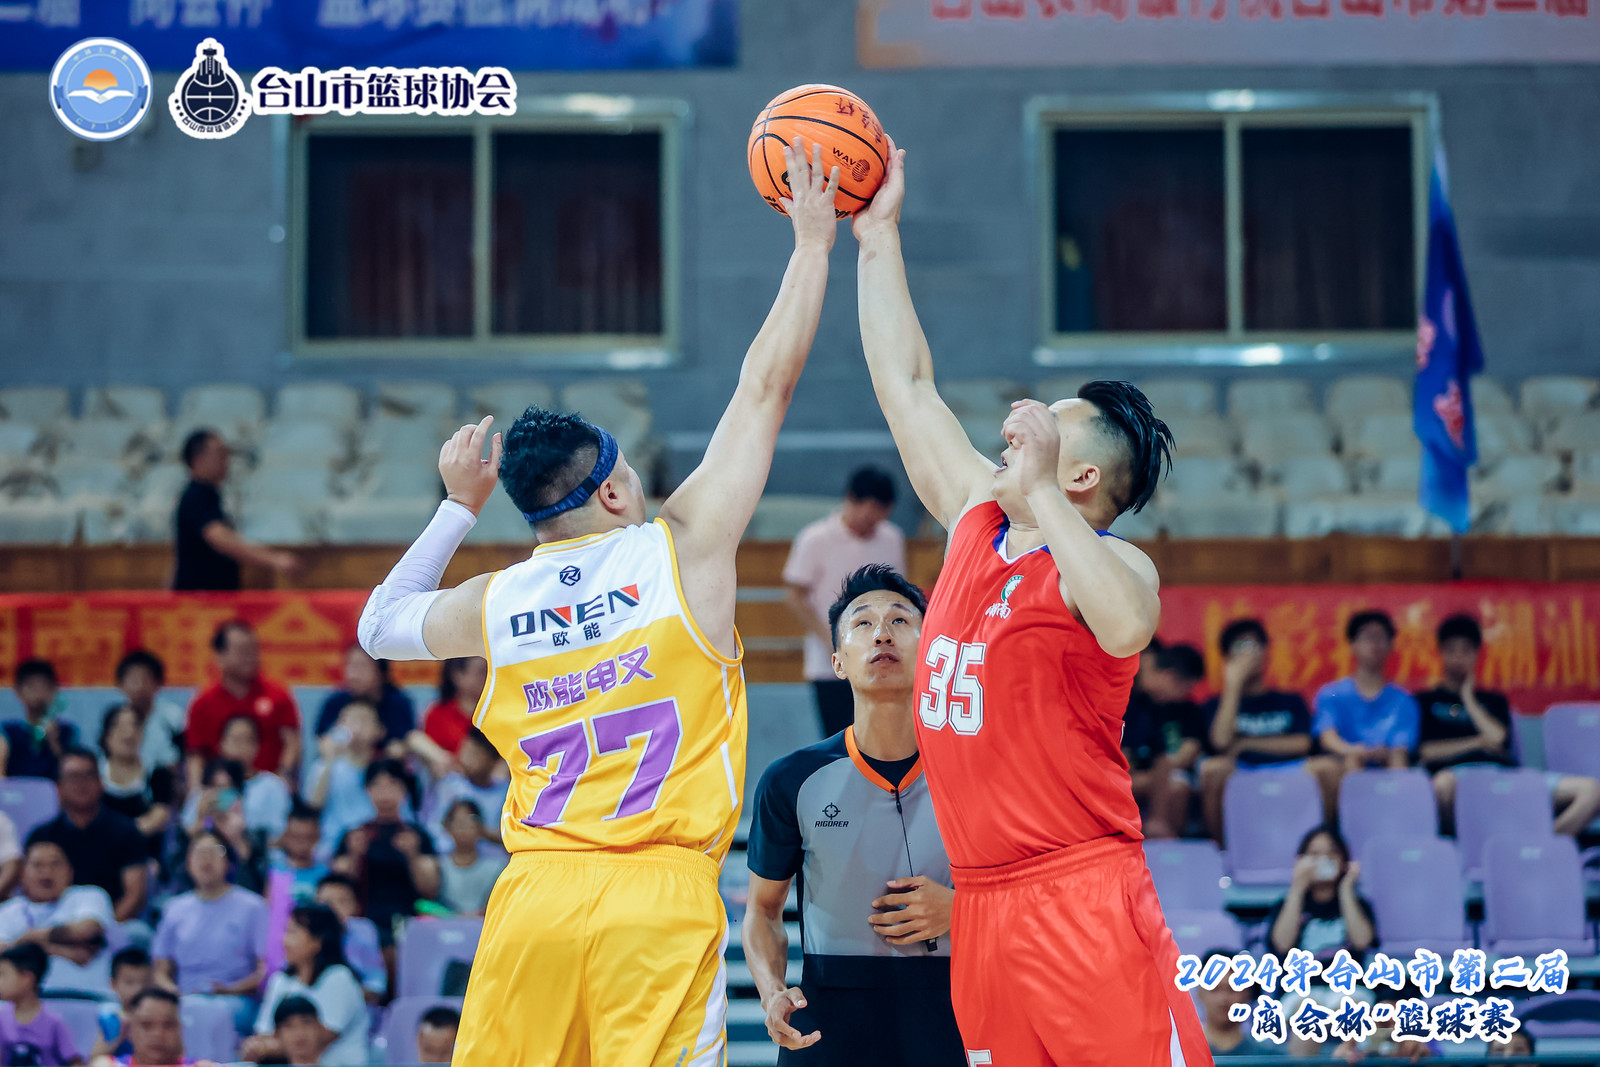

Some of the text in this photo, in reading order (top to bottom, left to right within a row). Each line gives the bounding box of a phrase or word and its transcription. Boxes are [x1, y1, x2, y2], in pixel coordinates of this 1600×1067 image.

[510, 583, 641, 638] ONEN
[552, 621, 602, 647] 欧能
[522, 644, 656, 714] 欧能电叉
[919, 634, 987, 736] 35
[518, 696, 683, 828] 77
[814, 820, 850, 828] RIGORER
